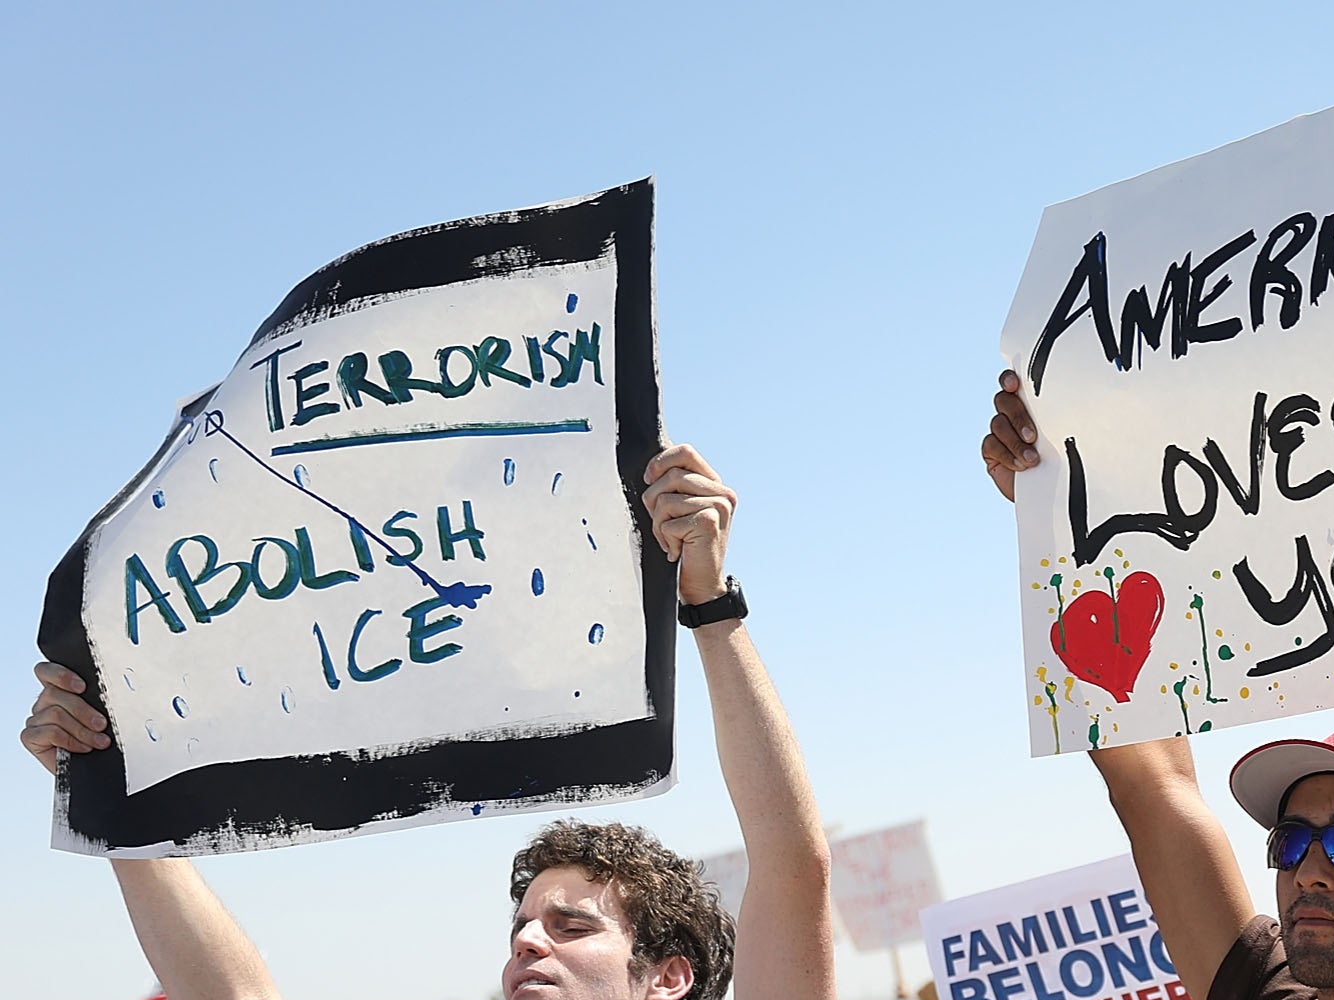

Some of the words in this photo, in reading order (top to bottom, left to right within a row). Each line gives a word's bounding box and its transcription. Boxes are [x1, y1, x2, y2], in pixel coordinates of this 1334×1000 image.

[249, 321, 606, 432] TERRORISM
[124, 500, 486, 646] ABOLISH
[312, 598, 465, 690] ICE
[942, 889, 1155, 978] FAMILIE
